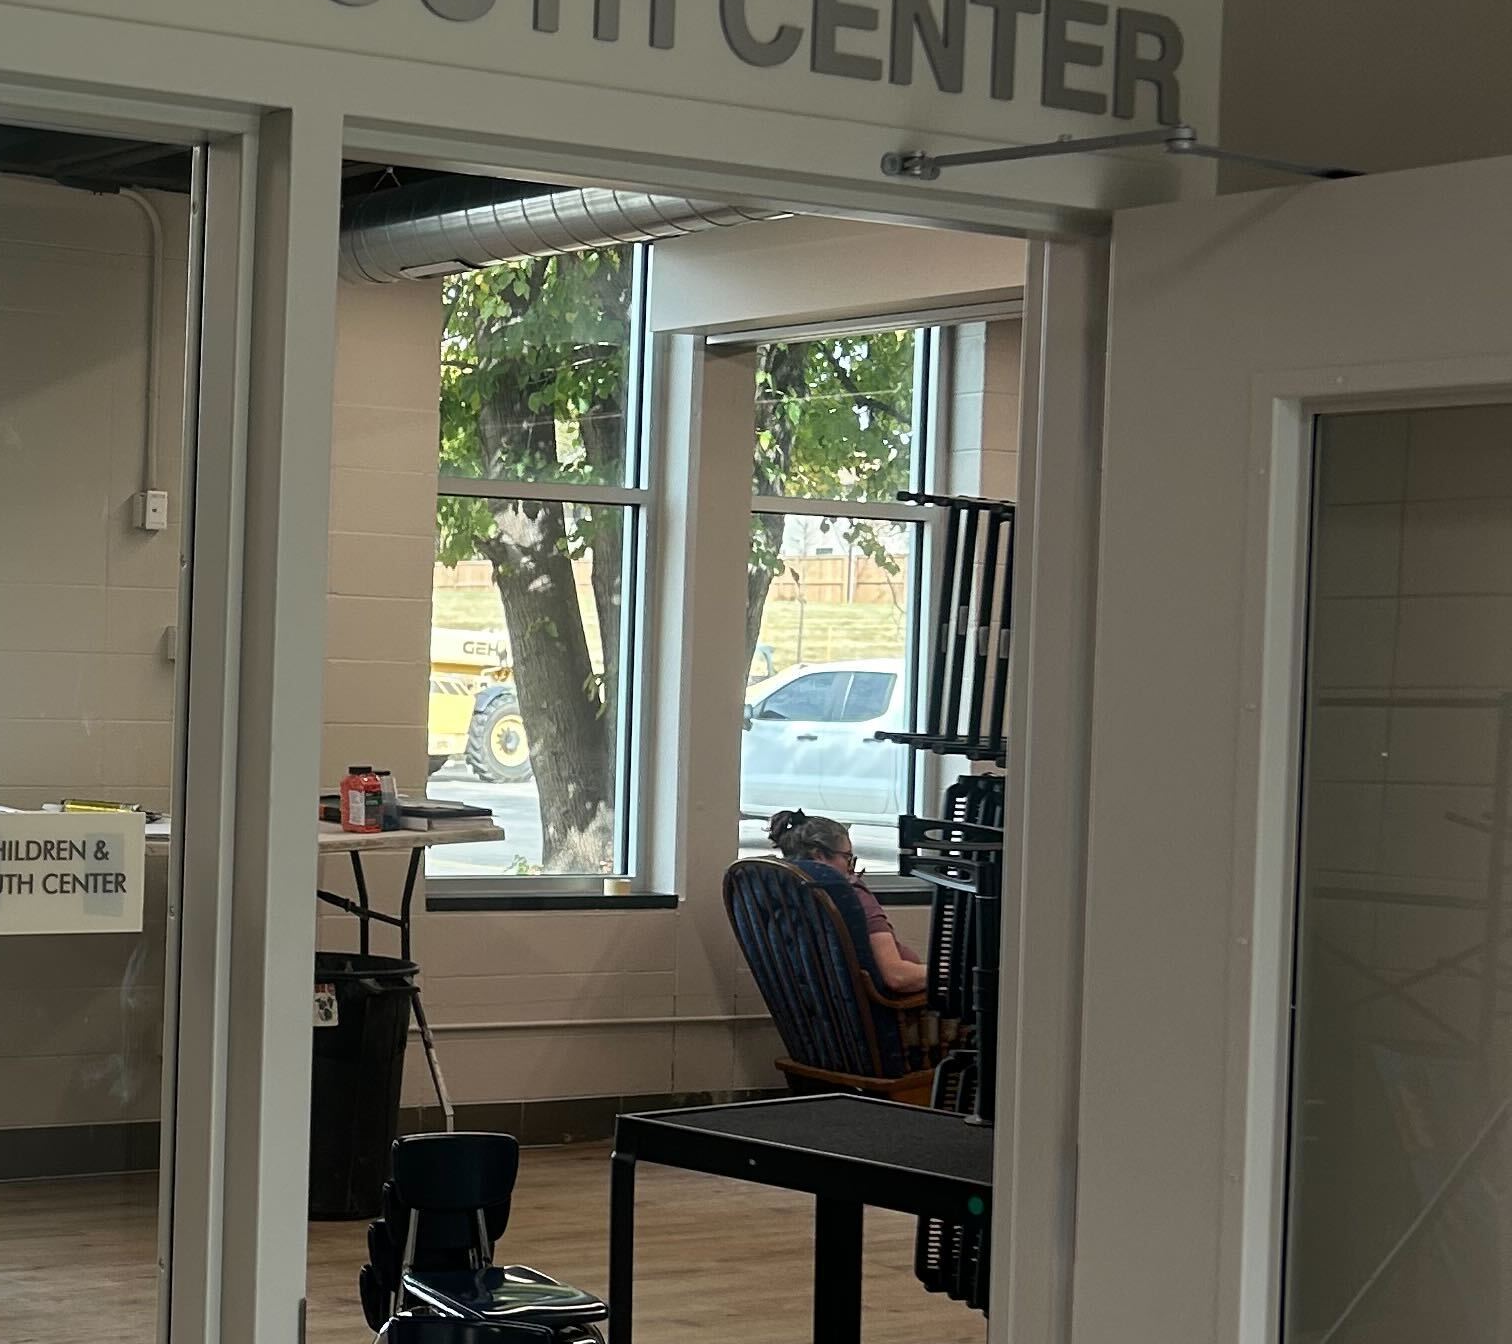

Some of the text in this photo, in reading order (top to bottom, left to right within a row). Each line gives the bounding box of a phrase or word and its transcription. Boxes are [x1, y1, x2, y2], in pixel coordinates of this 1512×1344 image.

[462, 640, 506, 656] GEH
[93, 839, 109, 861] &
[41, 872, 127, 895] CENTER
